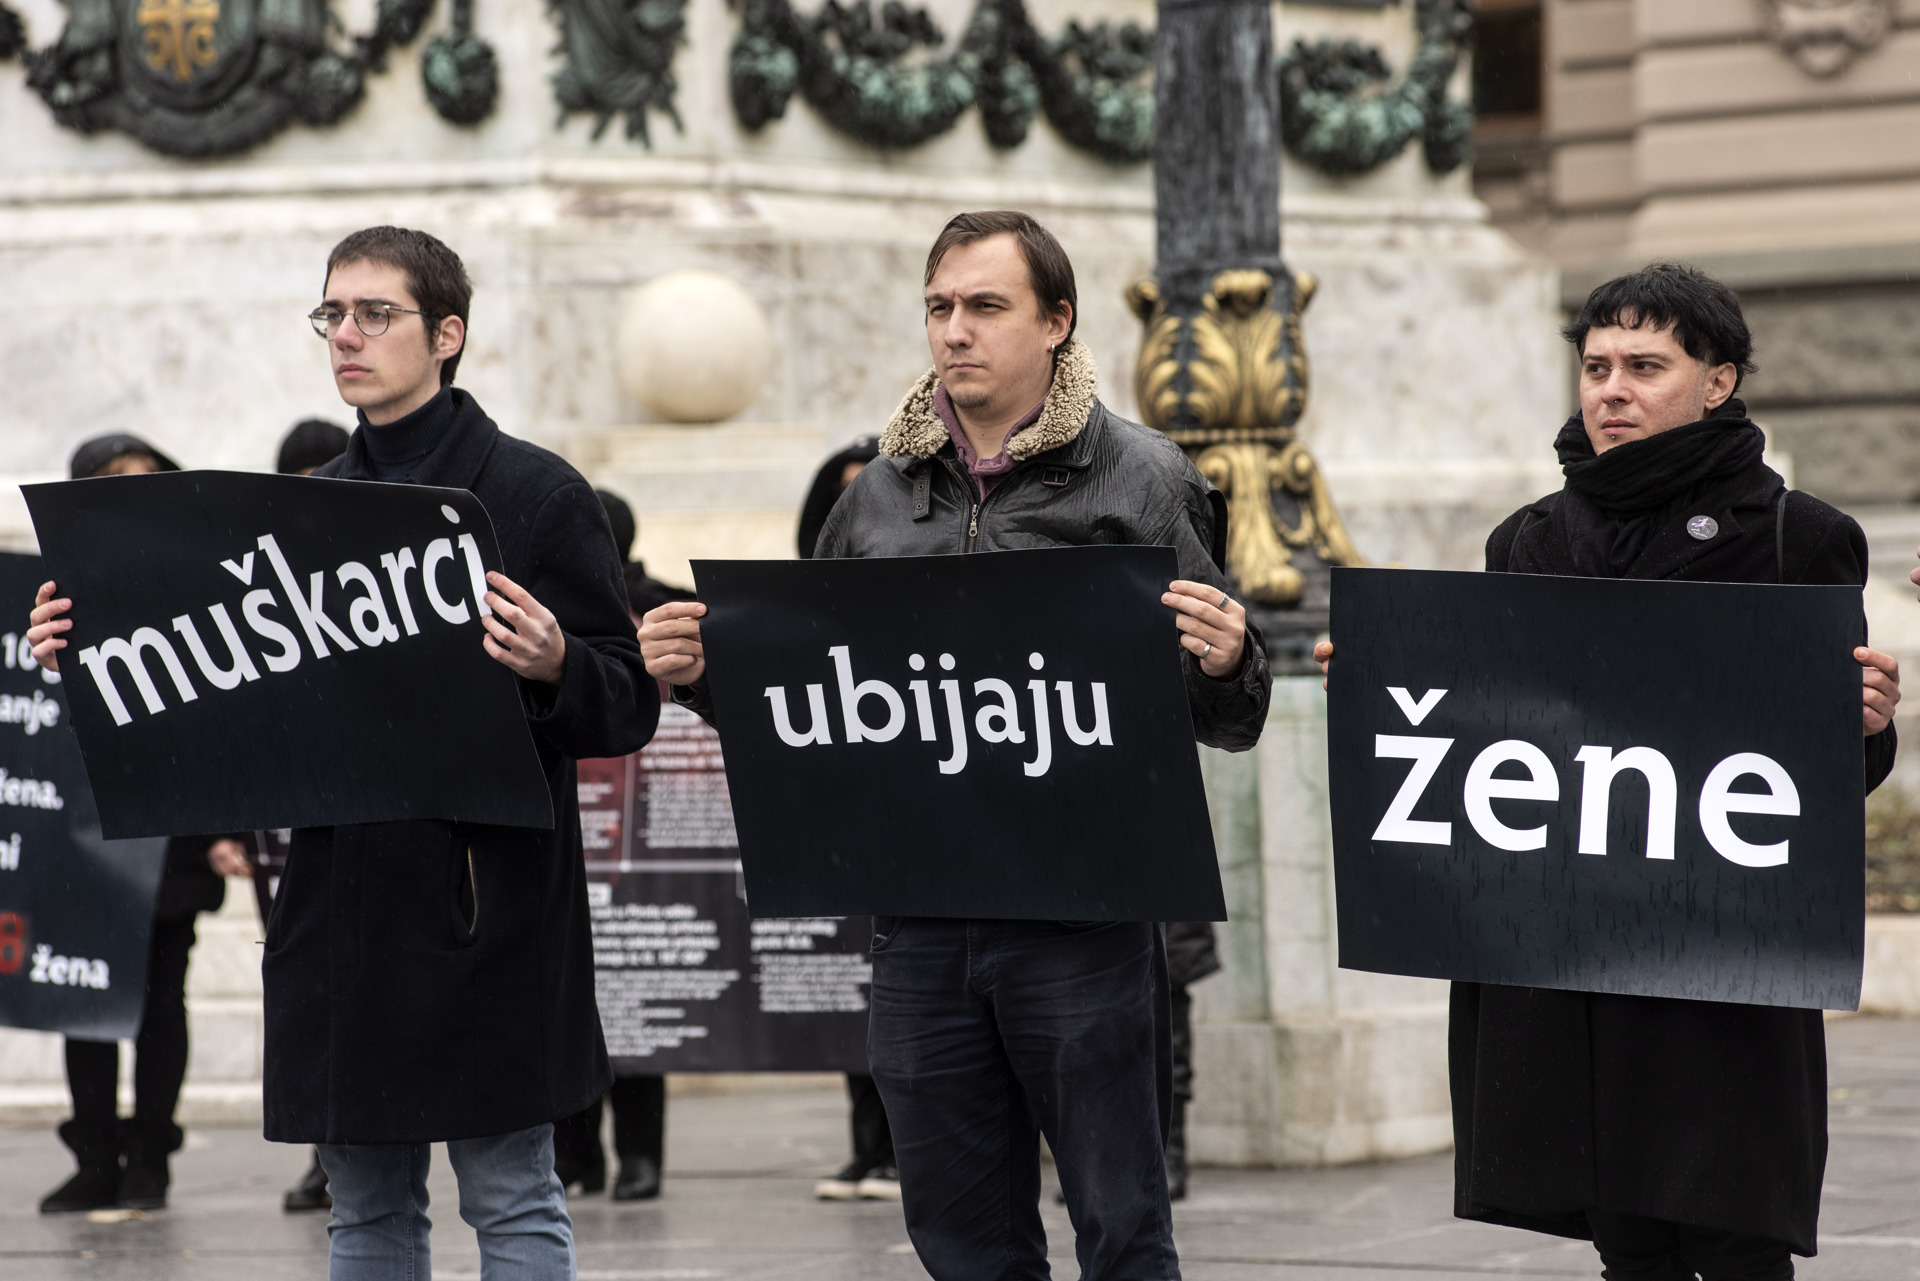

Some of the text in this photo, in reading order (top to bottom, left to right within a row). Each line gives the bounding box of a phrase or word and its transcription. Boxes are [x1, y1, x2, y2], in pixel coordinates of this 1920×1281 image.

[79, 505, 493, 727] muškarci
[764, 646, 1113, 778] ubijaju
[1372, 687, 1800, 867] žene
[29, 943, 110, 989] žena
